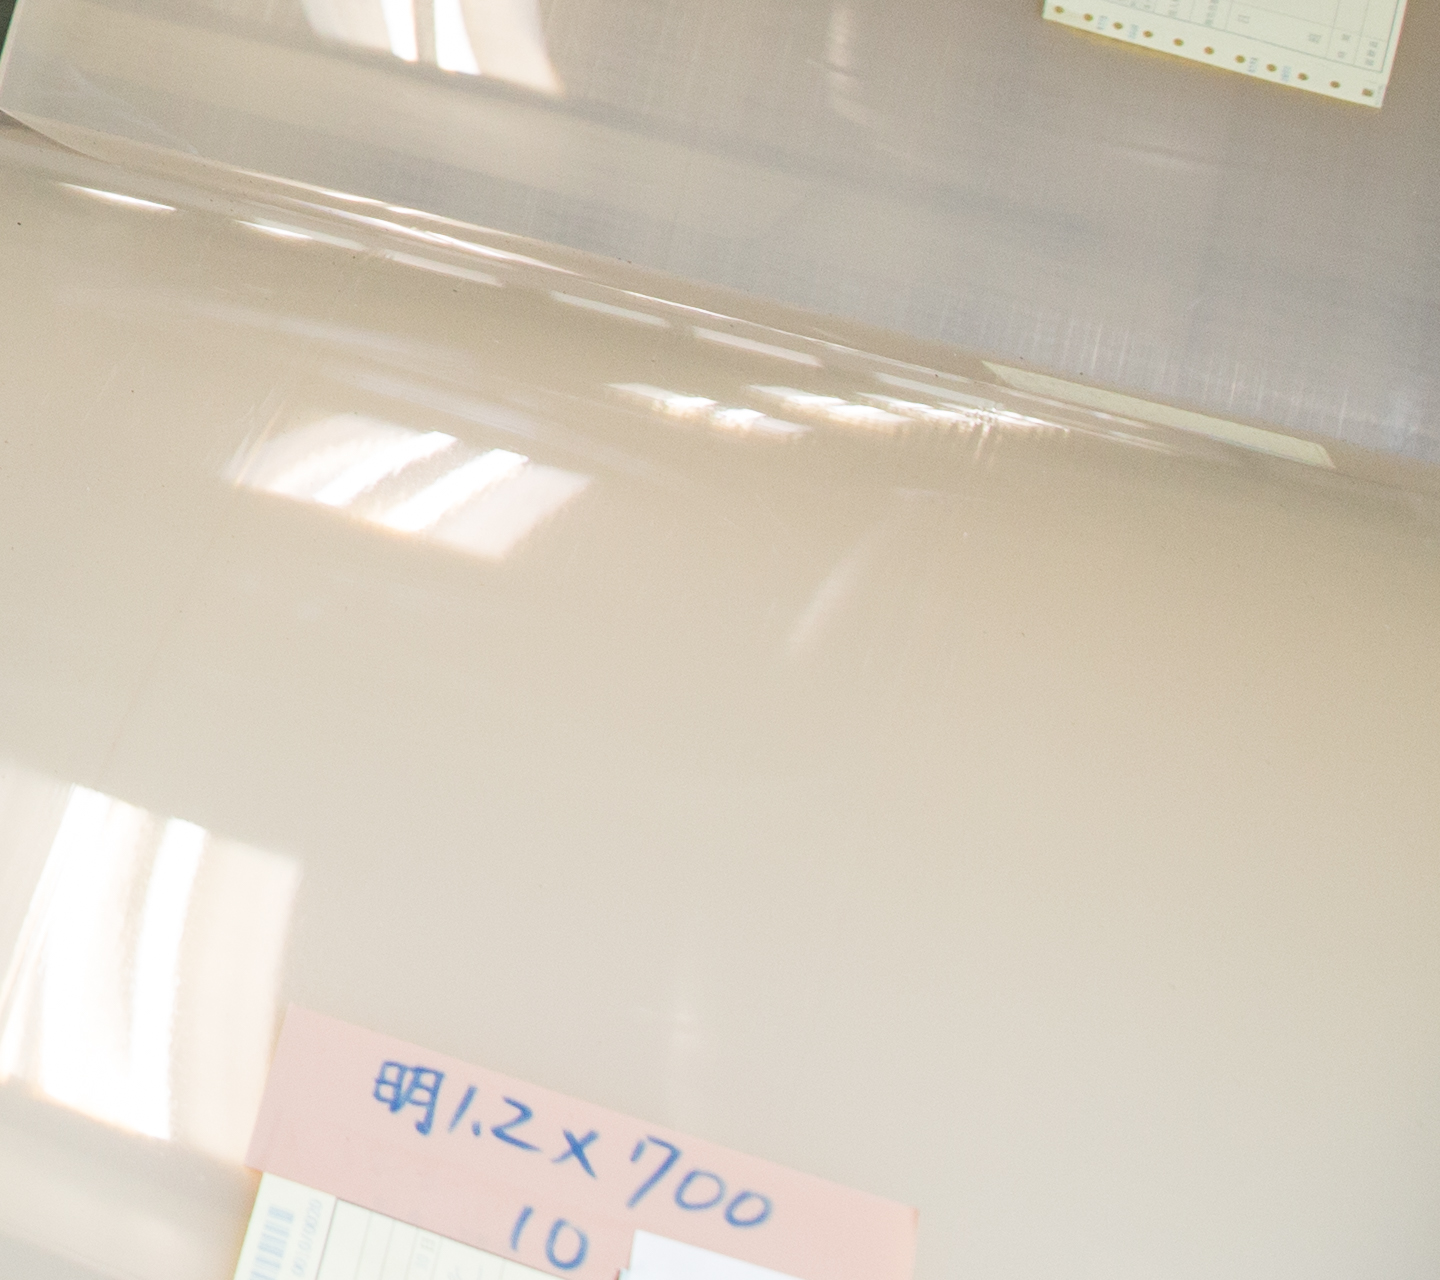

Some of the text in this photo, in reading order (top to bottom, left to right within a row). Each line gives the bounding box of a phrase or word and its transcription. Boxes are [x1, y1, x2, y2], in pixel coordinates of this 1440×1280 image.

[372, 1059, 446, 1136] 明
[447, 1084, 542, 1154] 1.2
[627, 1135, 774, 1230] 700
[509, 1205, 590, 1271] 10
